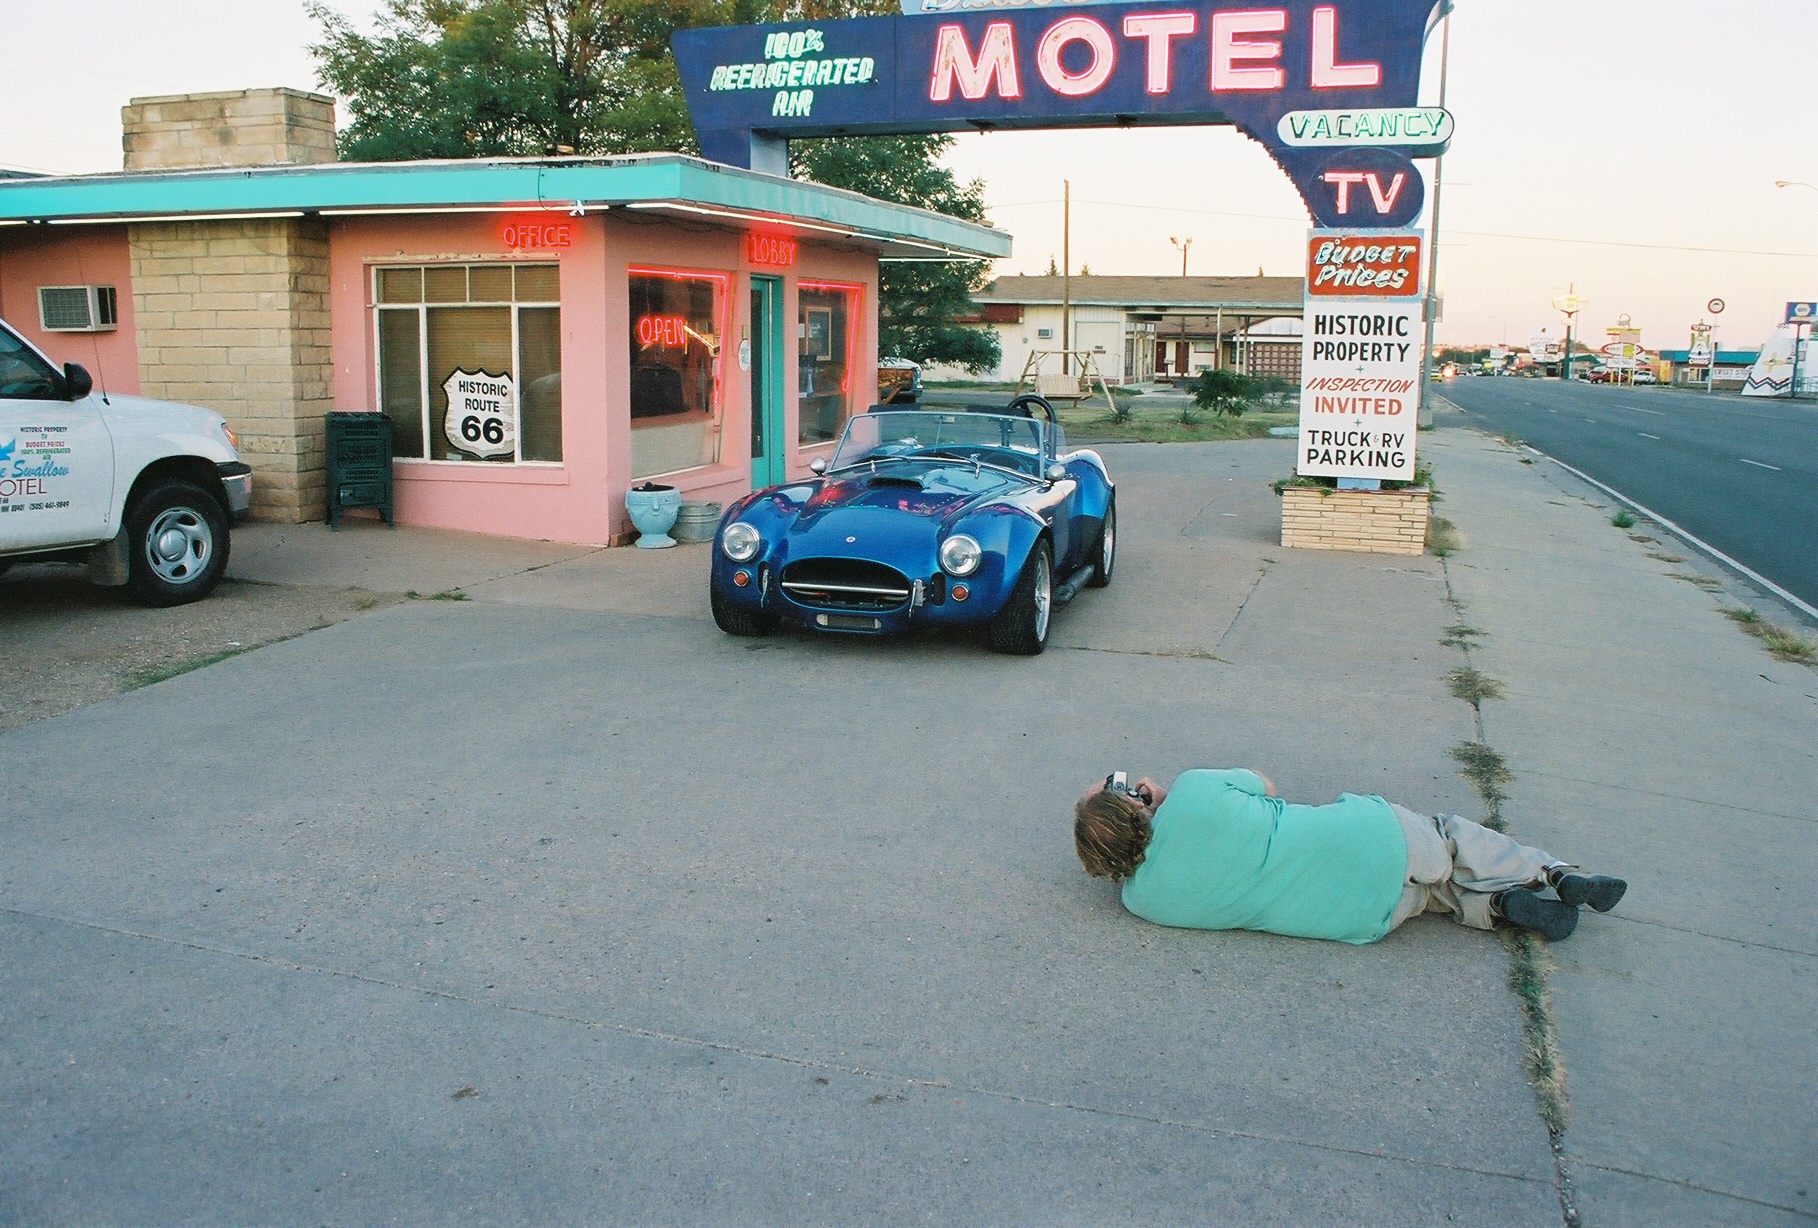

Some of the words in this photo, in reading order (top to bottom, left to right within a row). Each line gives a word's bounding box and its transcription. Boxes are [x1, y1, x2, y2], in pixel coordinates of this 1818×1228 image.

[765, 29, 824, 59] 100%
[930, 8, 1380, 100] MOTEL
[710, 57, 875, 91] REFRIGERATED
[772, 89, 814, 116] AIR
[1290, 112, 1445, 138] VACANCY
[1324, 173, 1405, 214] TV
[502, 223, 572, 248] OFFICE
[751, 235, 796, 265] LOBBY
[639, 318, 686, 345] OPEN
[1314, 315, 1409, 337] HISTORIC
[1313, 341, 1410, 362] PROPERTY
[459, 381, 508, 397] HISTORIC
[1305, 377, 1414, 393] INSPECTION
[465, 398, 500, 413] ROUTE
[1315, 396, 1403, 415] INVITED
[461, 415, 504, 444] 66
[1308, 430, 1371, 447] TRUCK
[1373, 434, 1379, 443] &
[1382, 433, 1405, 448] RV
[12, 460, 69, 478] Swallow
[1307, 448, 1405, 468] PARKING
[0, 478, 47, 496] OTEL
